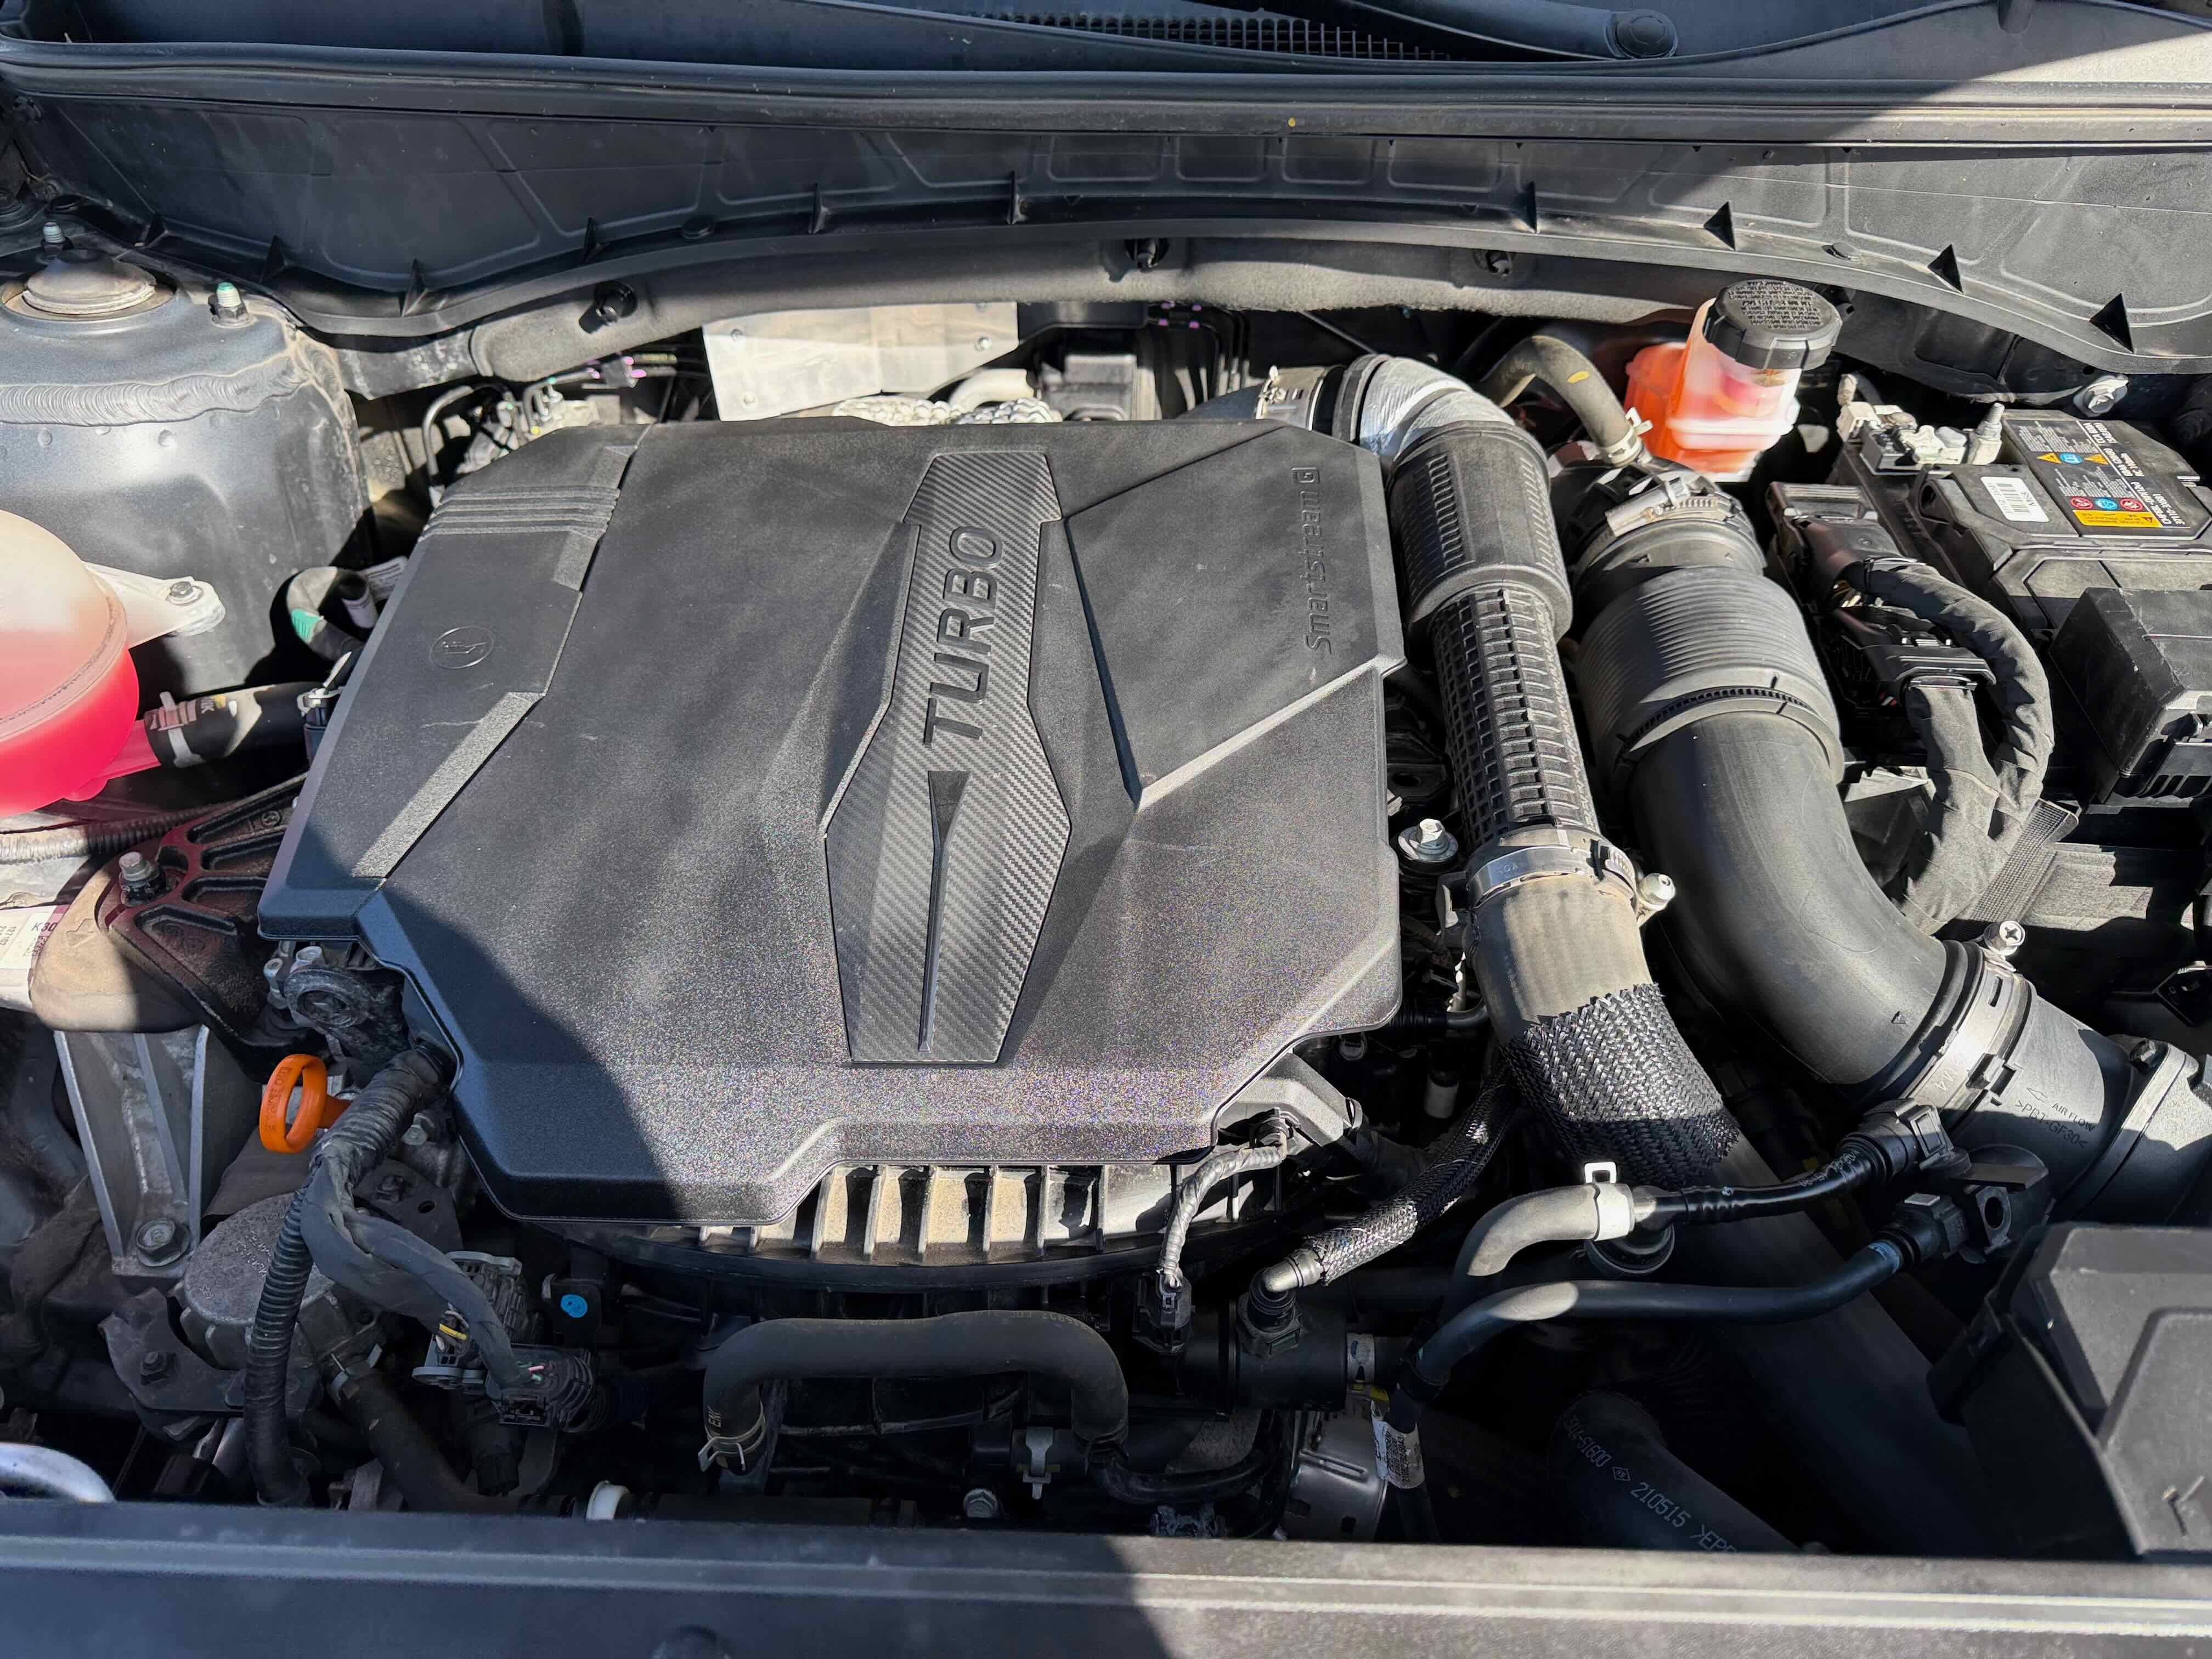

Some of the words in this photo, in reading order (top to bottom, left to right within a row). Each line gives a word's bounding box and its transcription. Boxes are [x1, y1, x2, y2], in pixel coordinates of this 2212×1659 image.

[1299, 490, 1332, 654] Smartstream
[923, 526, 1003, 749] TURBO
[2051, 1101, 2069, 1118] AIR
[2068, 1110, 2096, 1132] FLOW
[1629, 1481, 1691, 1528] 210515
